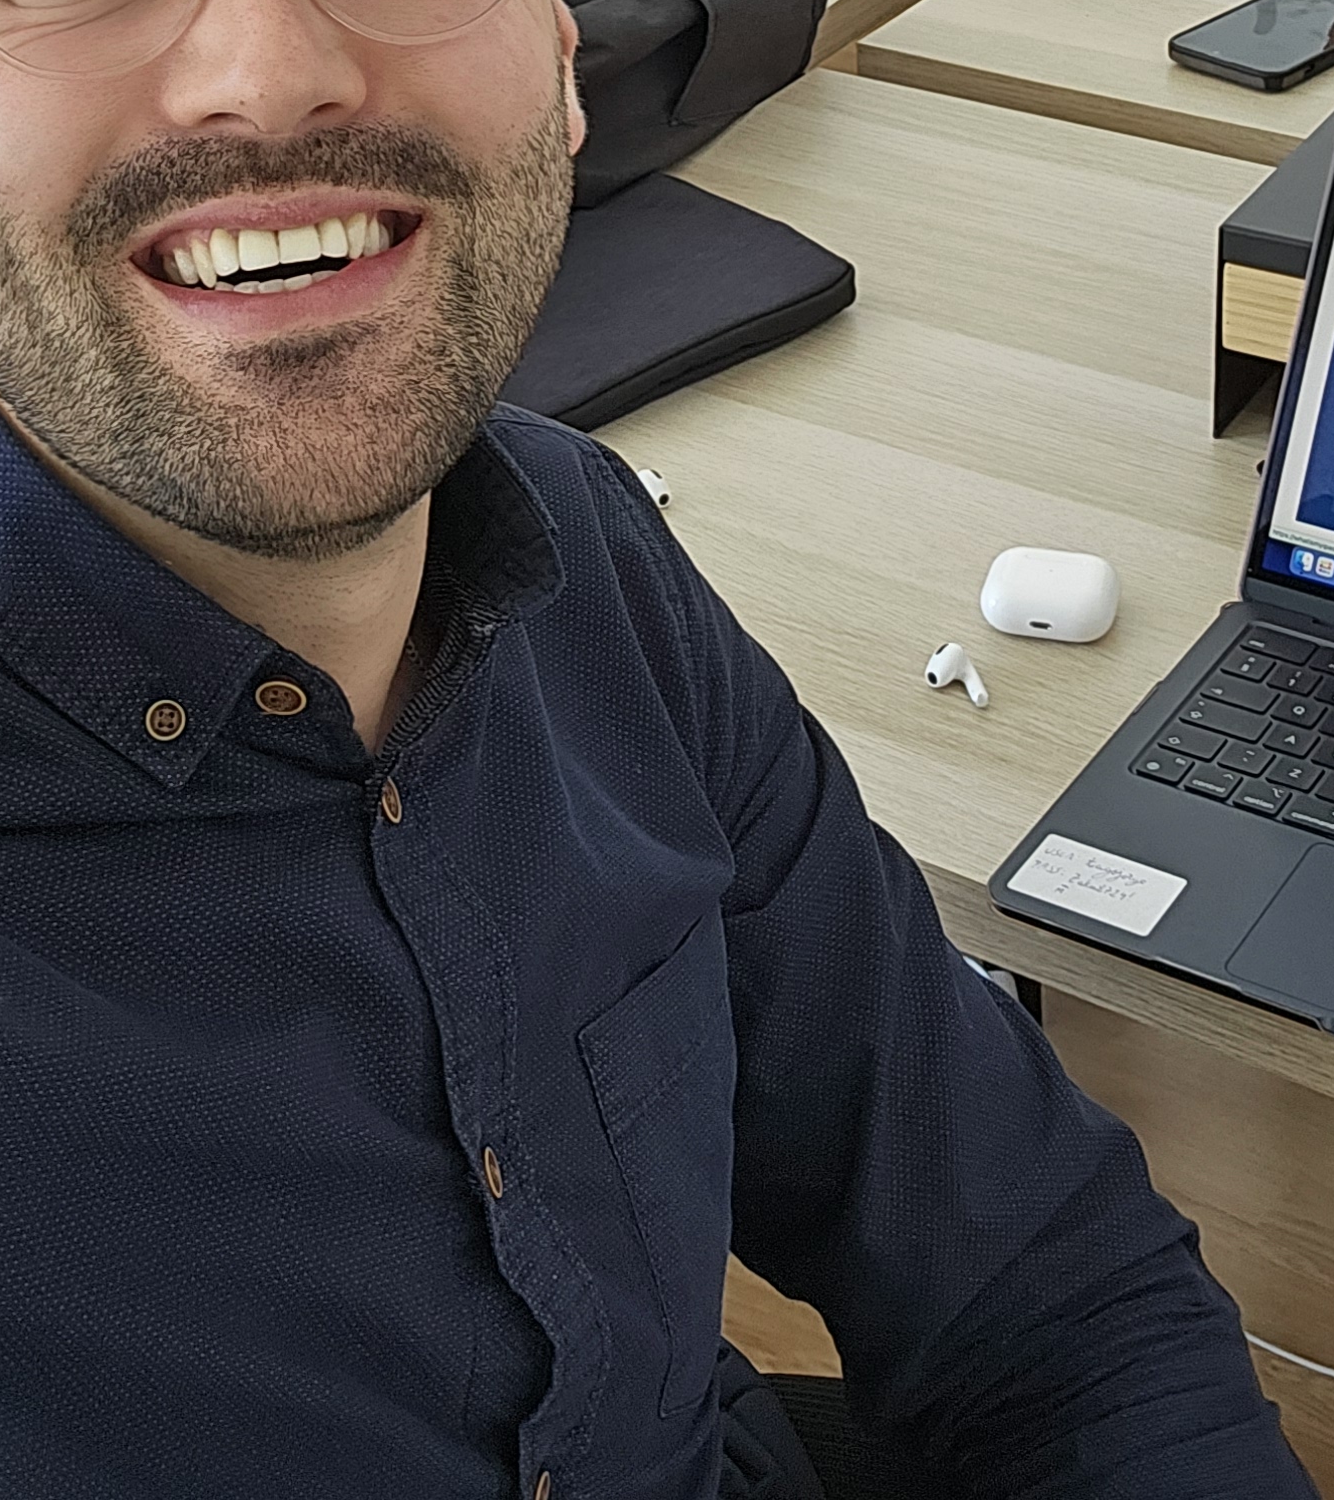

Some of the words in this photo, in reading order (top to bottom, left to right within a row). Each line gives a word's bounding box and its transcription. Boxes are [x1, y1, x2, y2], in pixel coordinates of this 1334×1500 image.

[1292, 705, 1305, 715] Q
[1283, 734, 1296, 745] A
[1287, 767, 1302, 778] Z
